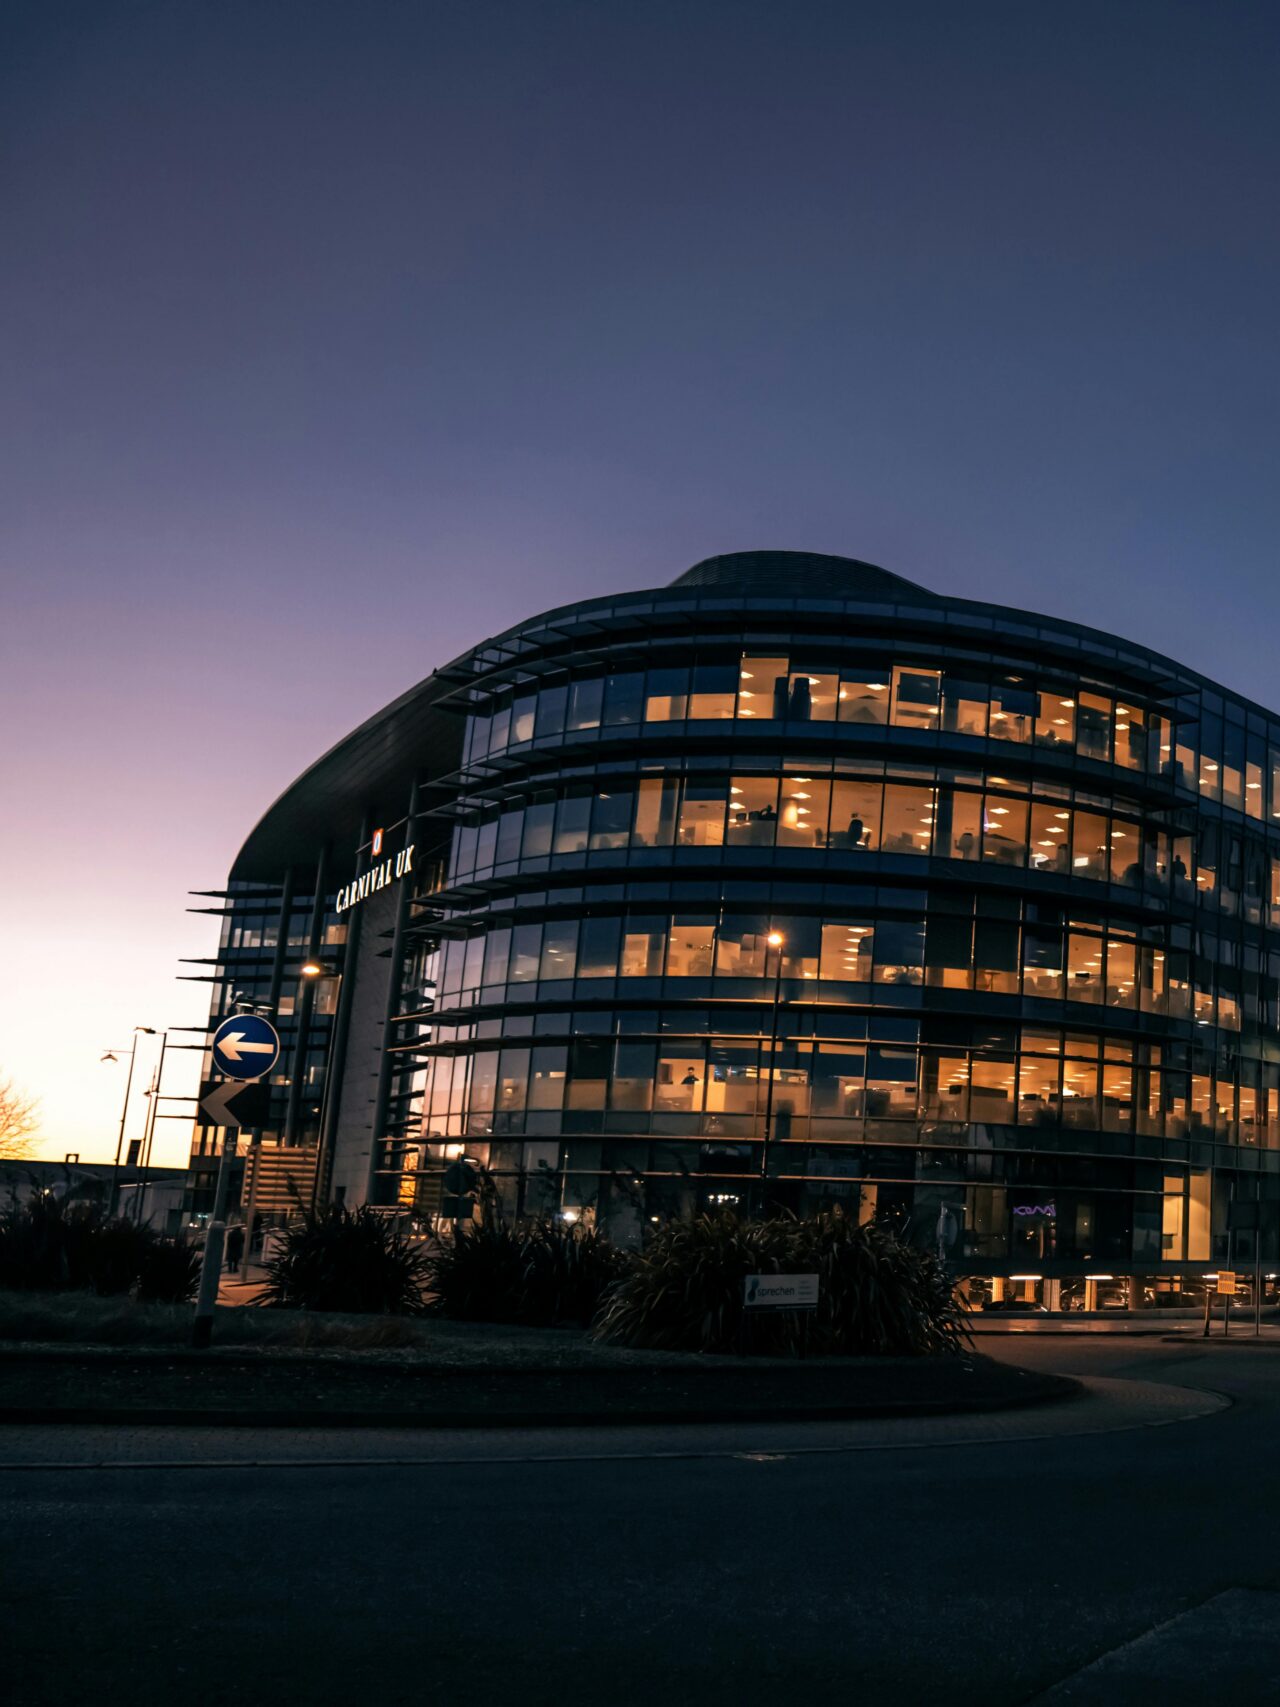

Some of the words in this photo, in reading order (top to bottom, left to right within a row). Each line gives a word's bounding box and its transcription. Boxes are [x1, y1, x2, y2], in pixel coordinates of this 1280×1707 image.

[336, 859, 392, 914] CARNIVAL
[396, 844, 415, 878] UK
[757, 1286, 795, 1297] sprechen
